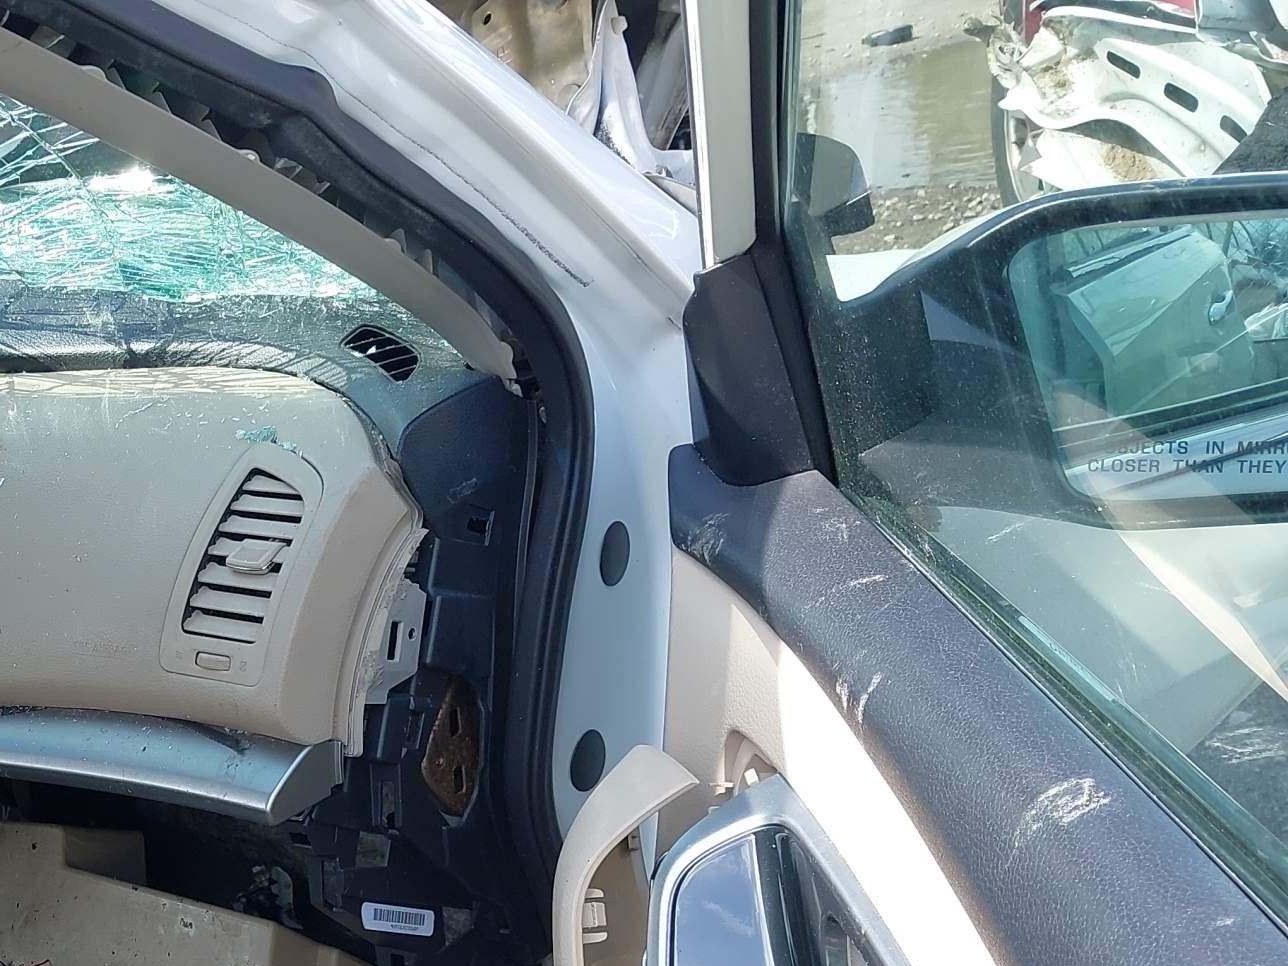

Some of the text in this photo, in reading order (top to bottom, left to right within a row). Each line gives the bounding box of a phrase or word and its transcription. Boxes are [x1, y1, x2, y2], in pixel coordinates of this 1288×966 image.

[1206, 441, 1224, 455] IN
[1237, 441, 1288, 455] MIRR
[1087, 458, 1288, 474] CLOSER THAN THEY
